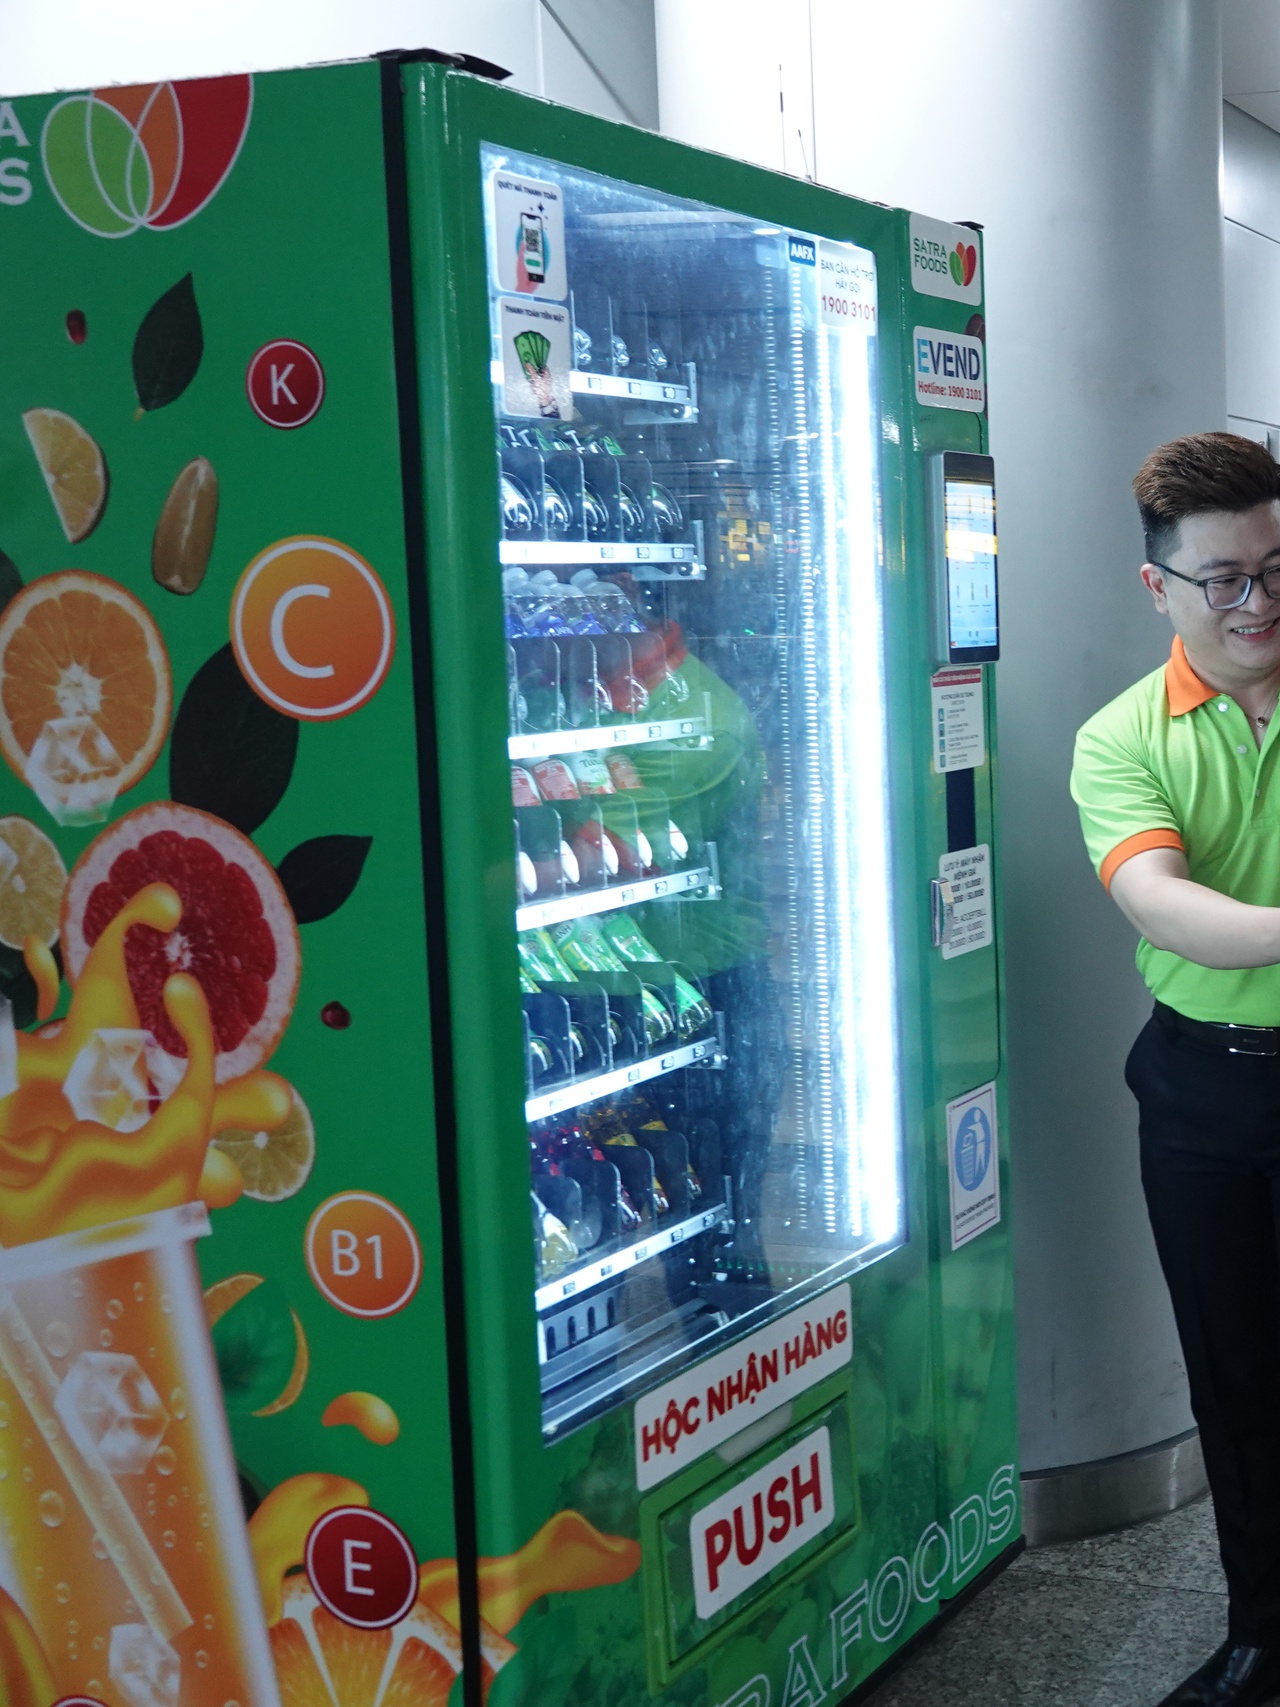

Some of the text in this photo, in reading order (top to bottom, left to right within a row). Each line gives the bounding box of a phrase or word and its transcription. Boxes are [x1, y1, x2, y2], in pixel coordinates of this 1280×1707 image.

[791, 243, 815, 262] AAFX
[913, 237, 947, 259] SATRA
[914, 254, 948, 275] FOODS
[822, 295, 876, 322] 1900 3101
[916, 338, 981, 381] EVEND
[270, 364, 298, 405] K
[917, 380, 982, 401] Hotline: 1900 3101
[270, 584, 335, 680] C
[330, 1229, 384, 1279] B1
[642, 1309, 848, 1463] HỘC NHẬN HÀNG
[704, 1452, 823, 1592] PUSH
[343, 1539, 375, 1596] E
